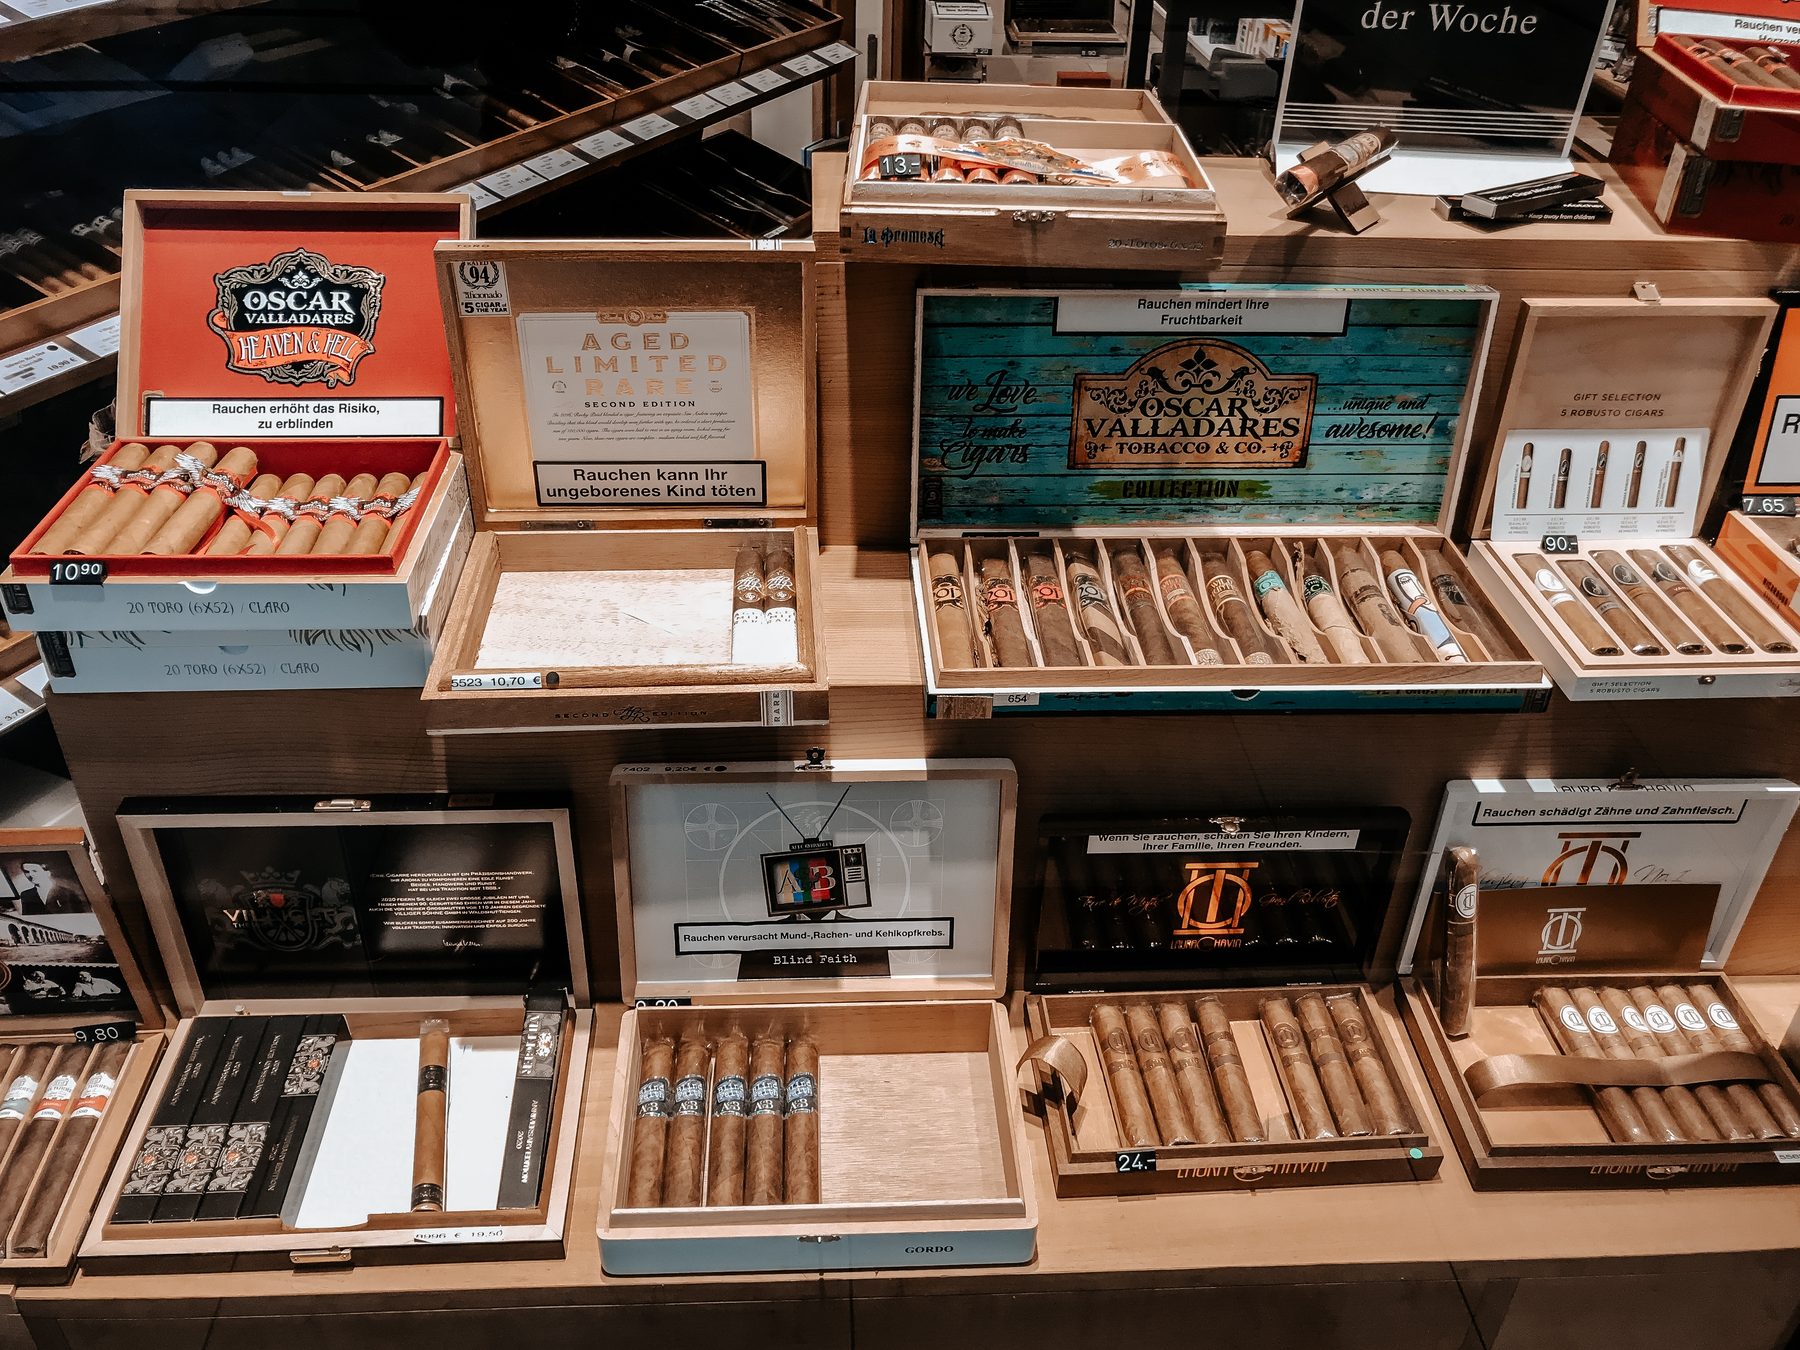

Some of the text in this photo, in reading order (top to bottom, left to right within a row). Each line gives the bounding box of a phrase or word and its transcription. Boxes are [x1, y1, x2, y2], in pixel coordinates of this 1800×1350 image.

[1361, 1, 1538, 35] der Woche
[1734, 18, 1783, 32] Rauchen
[469, 266, 490, 284] 94
[243, 290, 355, 314] OSCAR
[1137, 298, 1270, 310] Rauchen mindert Ihre
[245, 312, 354, 326] VALLADARES
[1160, 314, 1243, 326] Fruchtbarkeit
[238, 332, 359, 361] HEAVEN & HELL
[581, 332, 690, 351] AGED
[546, 355, 728, 374] LIMITED
[585, 378, 694, 396] RARE
[973, 369, 1037, 414] Love
[643, 400, 696, 408] EDITION
[1397, 392, 1430, 410] and
[1573, 393, 1662, 402] GIFT SELECTION
[212, 402, 380, 417] Rauchen erhöht das Risiko,
[1139, 397, 1249, 418] OSCAR
[1560, 409, 1665, 417] 5 ROBUSTO CIGARS
[258, 418, 334, 430] zu erblinden
[981, 419, 1027, 438] make
[1083, 417, 1300, 442] VALLADARES
[1325, 411, 1440, 439] awesome!
[1116, 441, 1267, 455] TOBACCO & CO.
[940, 438, 1032, 480] Cigars
[573, 468, 728, 482] Rauchen kann Ihr
[546, 484, 757, 501] ungeborenes Kind töten
[1122, 479, 1240, 498] COLLECTION
[1743, 498, 1786, 512] 7.65
[126, 602, 145, 614] 20
[148, 602, 185, 614] TORO
[188, 600, 236, 617] (6X52)
[248, 601, 290, 614] CLARO
[165, 663, 182, 676] 20
[186, 663, 218, 676] TORO
[222, 662, 267, 677] (6X52)
[280, 662, 320, 674] CLARO
[451, 676, 542, 688] 5523 10,70 €
[1008, 694, 1028, 704] 654
[1482, 804, 1736, 818] Rauchen schädigt Zähne und Zahnfleisch.
[1098, 830, 1351, 843] Wenn Sie rauchen, schaden Sie Ihren Kindern,
[1142, 840, 1303, 852] Ihrer Familie, Ihren Freunden.
[683, 934, 726, 942] Rauchen
[728, 932, 778, 942] verursacht
[855, 930, 873, 939] und
[875, 928, 946, 940] Kehlkopfkrebs.
[773, 954, 858, 966] Blind Faith
[76, 1026, 120, 1042] 9.80
[904, 1244, 955, 1255] GORDO
